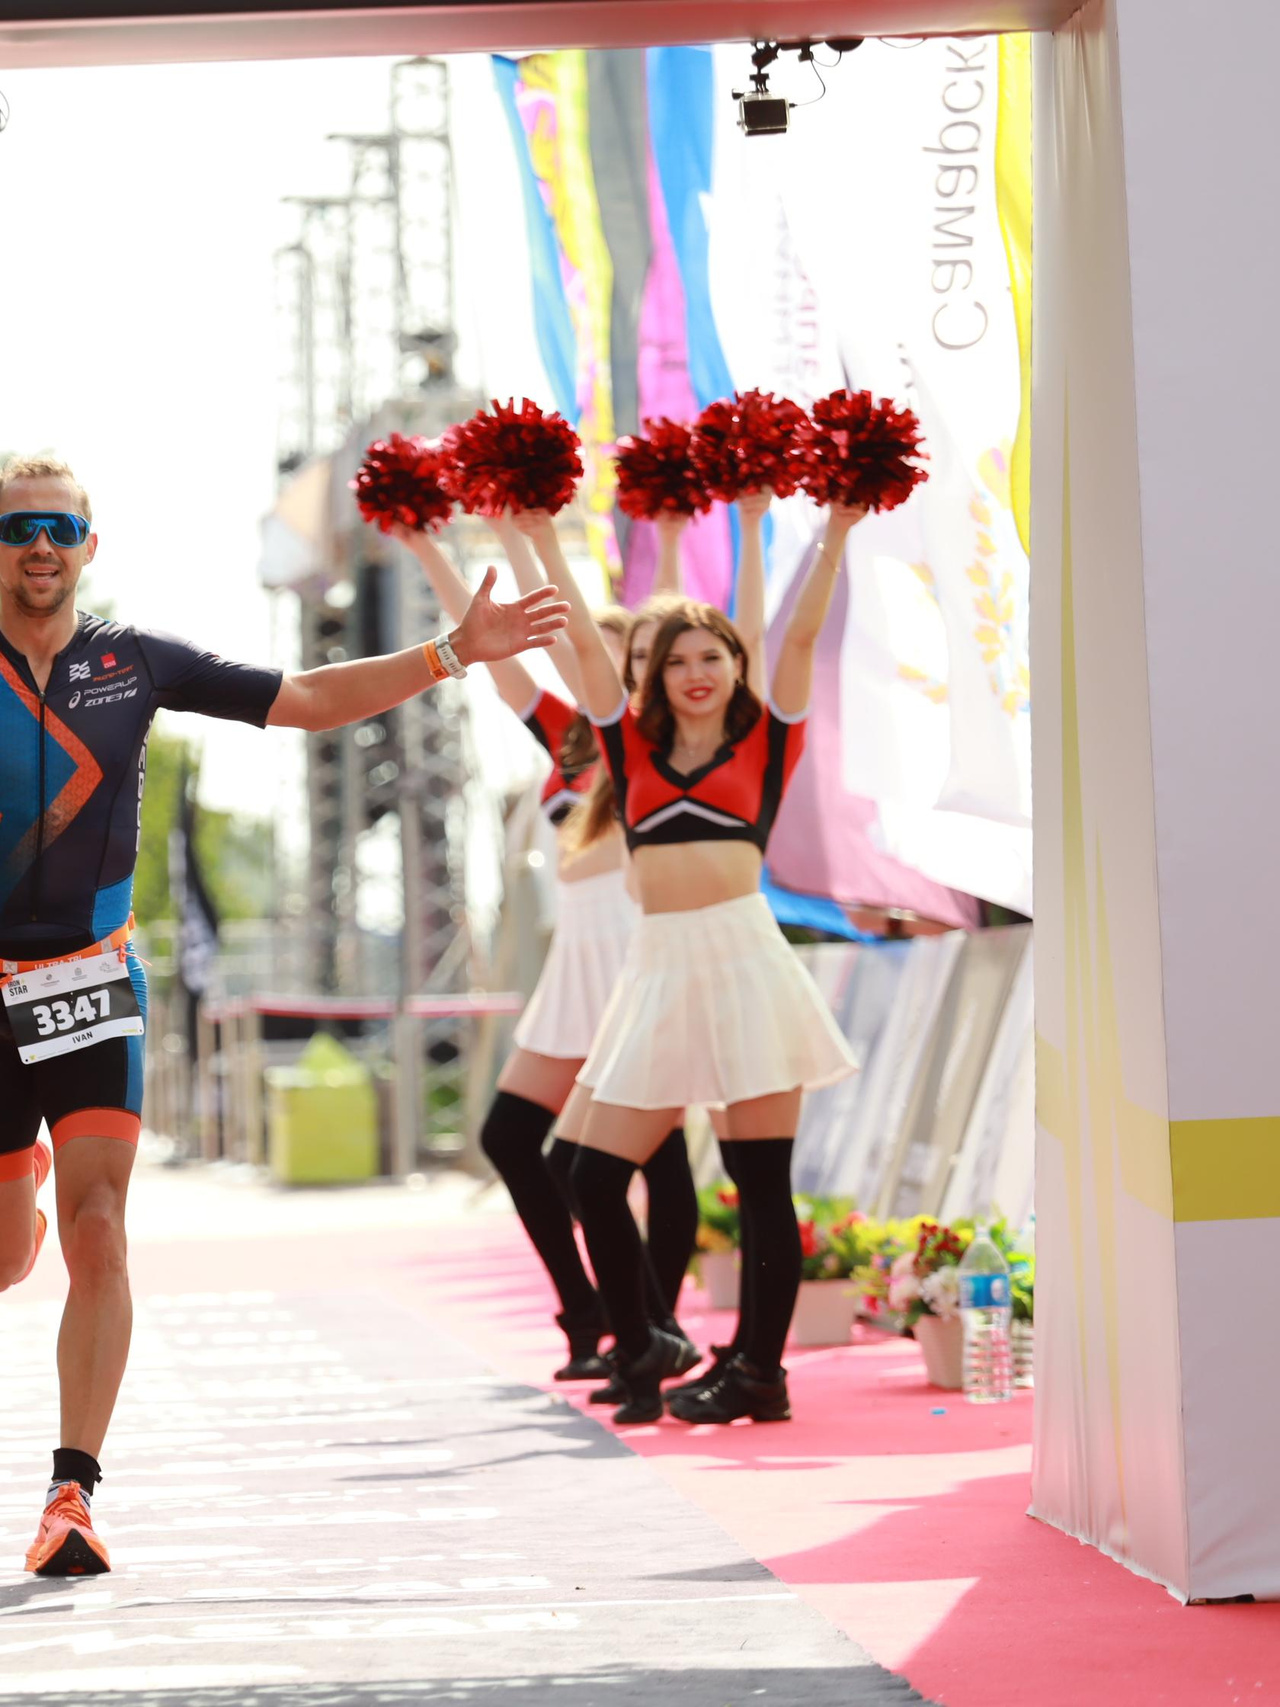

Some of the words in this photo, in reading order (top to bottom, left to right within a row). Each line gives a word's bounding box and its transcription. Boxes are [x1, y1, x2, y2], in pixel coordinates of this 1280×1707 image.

[84, 677, 137, 695] POWERUP
[9, 985, 28, 996] STAR
[32, 989, 110, 1036] 3347
[72, 1031, 93, 1044] IVAN
[186, 1576, 552, 1599] STAR
[190, 1612, 581, 1639] STAR
